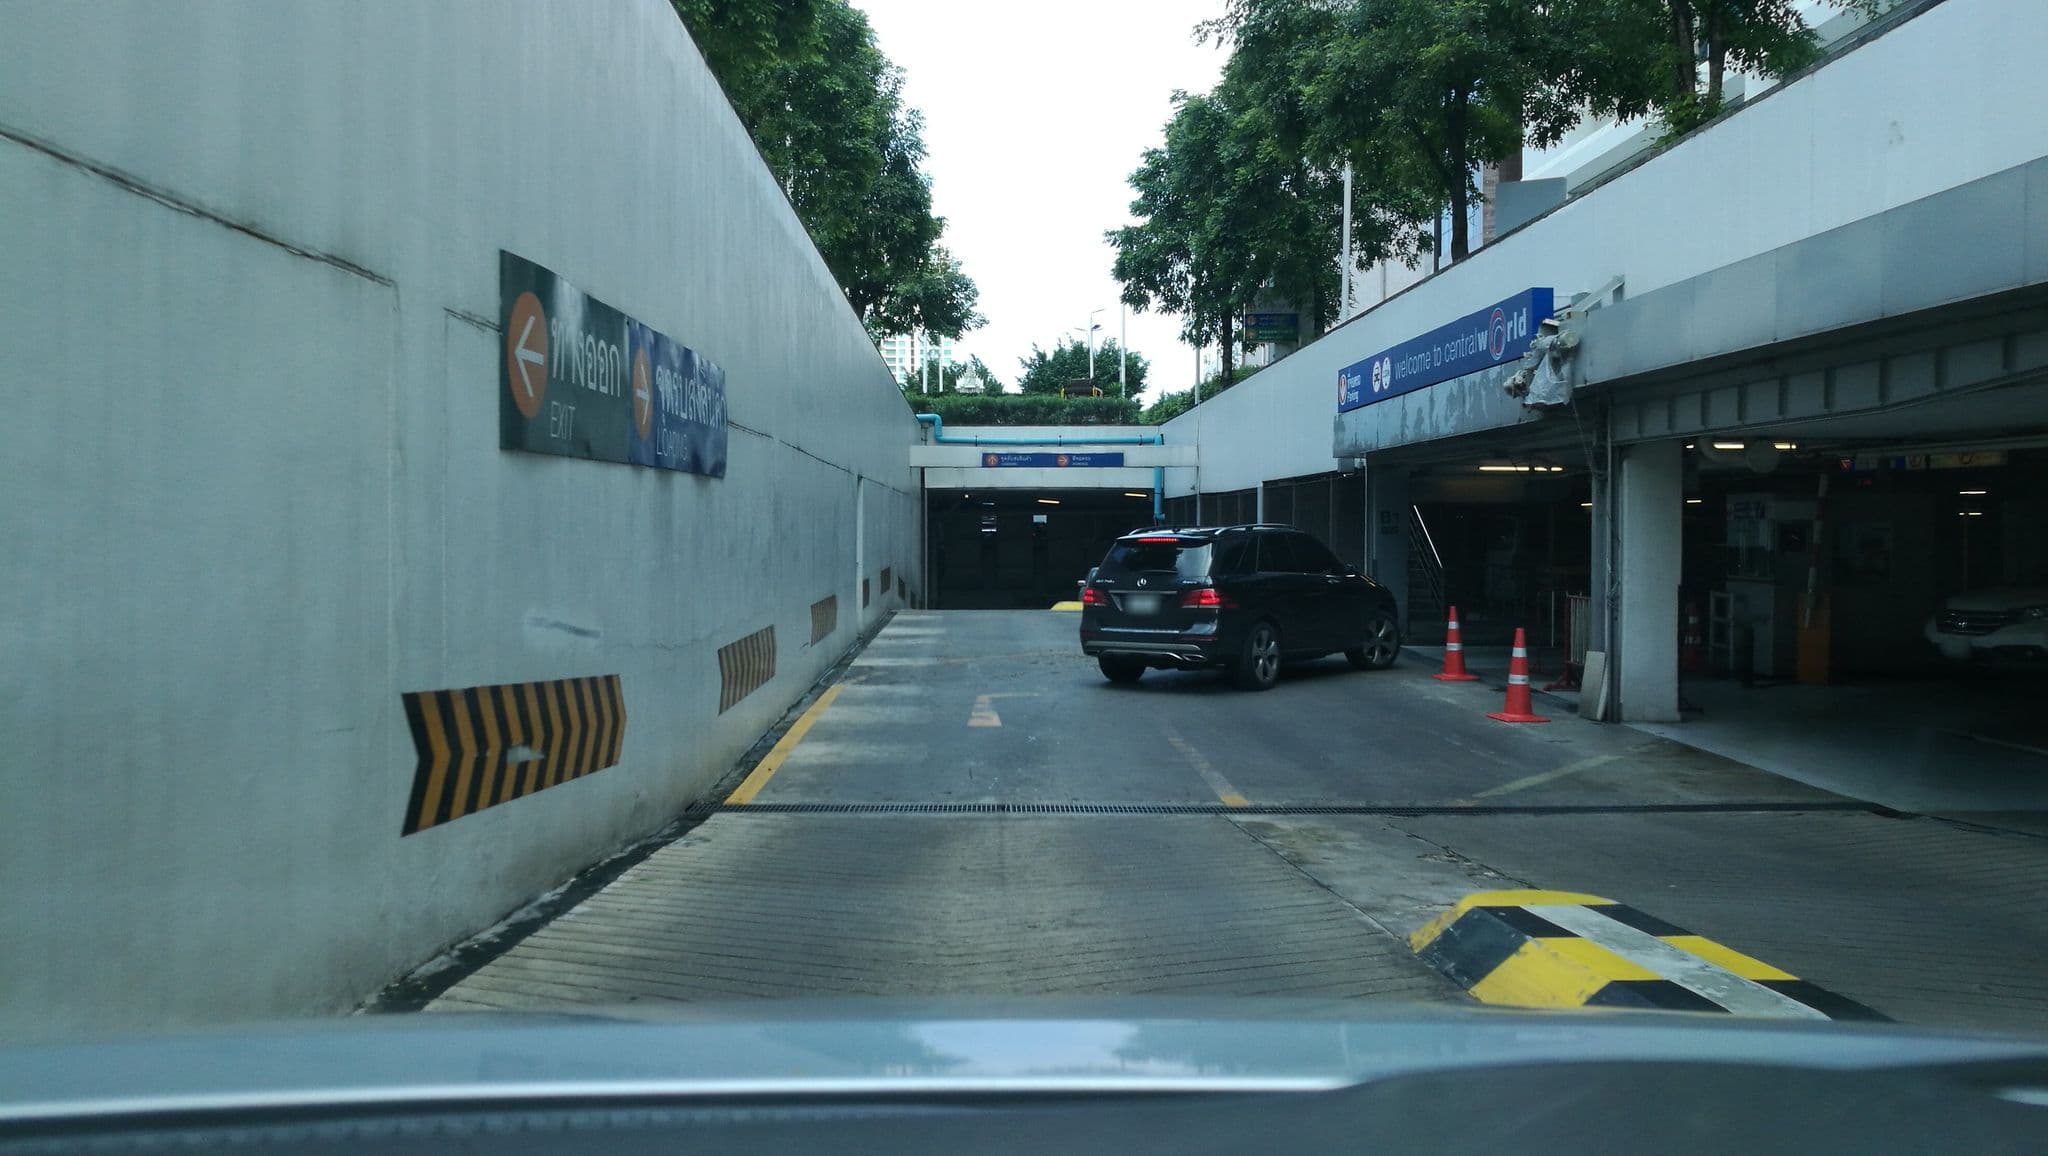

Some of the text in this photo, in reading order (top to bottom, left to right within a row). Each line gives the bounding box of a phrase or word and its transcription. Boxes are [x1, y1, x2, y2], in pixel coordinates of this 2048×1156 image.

[552, 317, 621, 398] ทางออก
[1394, 352, 1431, 380] welcome
[1433, 344, 1442, 367] to
[550, 401, 576, 441] EXIT
